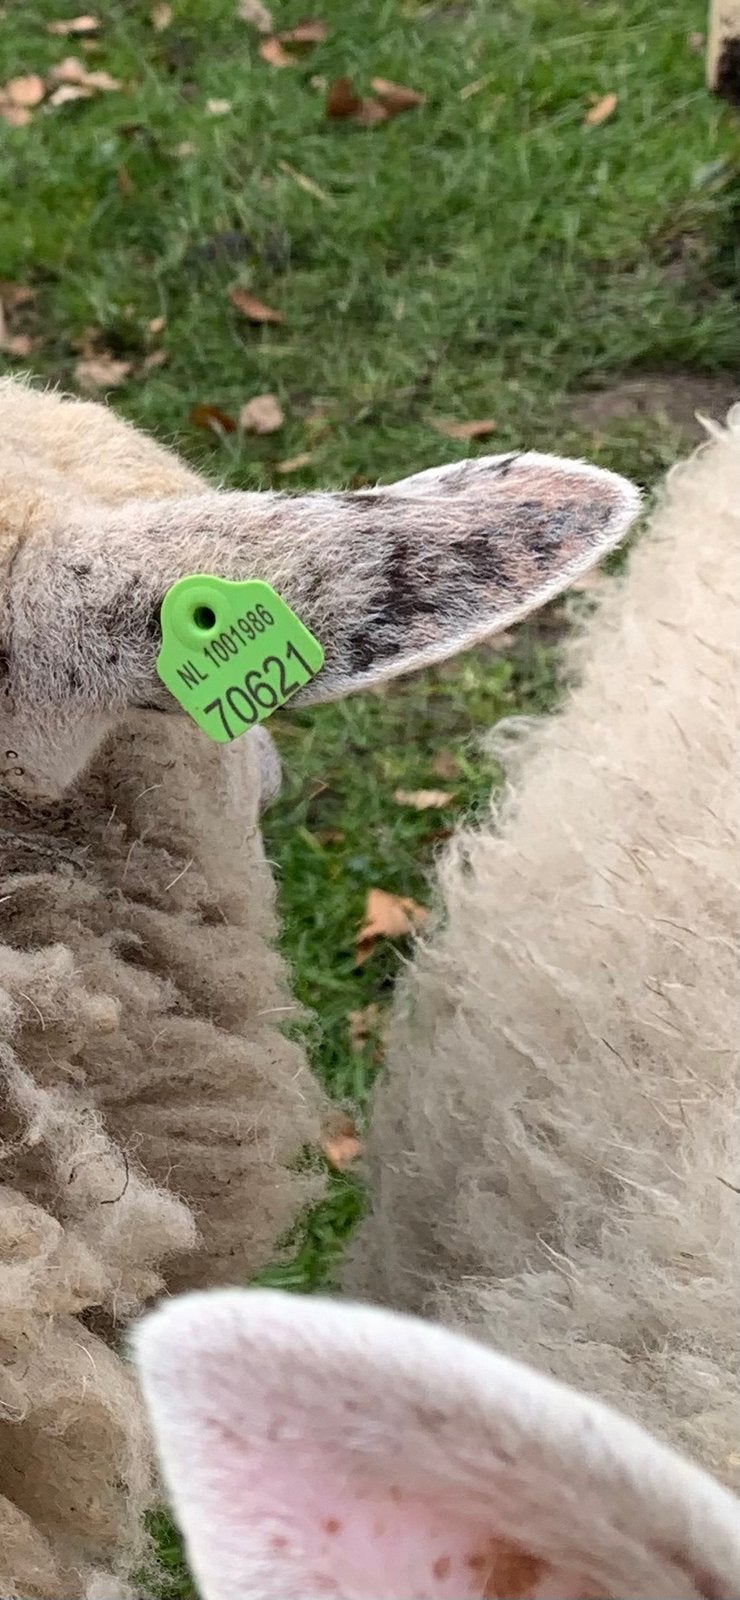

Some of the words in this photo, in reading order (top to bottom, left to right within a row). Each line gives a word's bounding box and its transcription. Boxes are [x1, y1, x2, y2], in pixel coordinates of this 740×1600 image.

[176, 660, 209, 690] NL
[203, 603, 275, 668] 1001986
[203, 640, 315, 739] 70621
